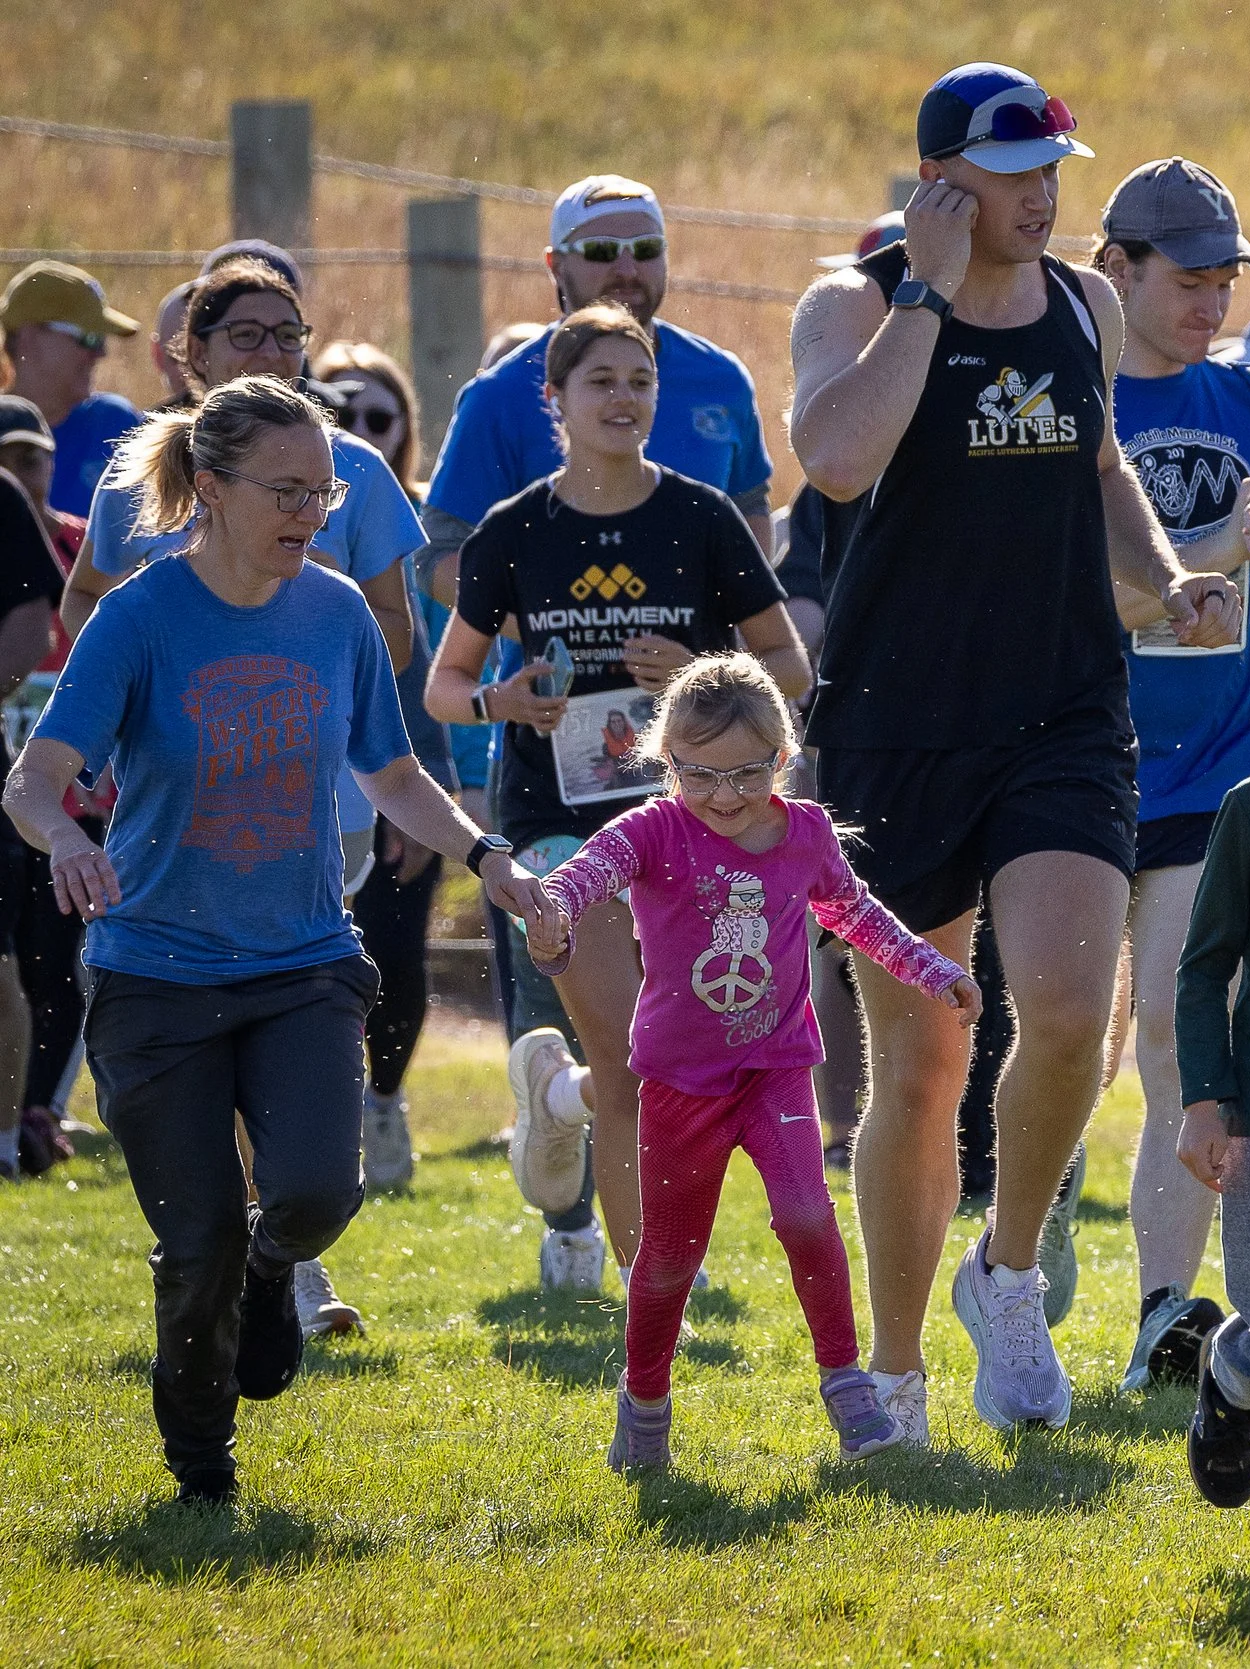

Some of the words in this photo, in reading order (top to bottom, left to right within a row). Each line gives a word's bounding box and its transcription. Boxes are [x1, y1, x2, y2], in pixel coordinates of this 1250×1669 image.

[1198, 189, 1228, 220] Y
[961, 355, 987, 366] asics
[968, 415, 1078, 447] LUTES
[968, 449, 995, 457] PACIFIC
[997, 447, 1036, 455] LUTHERAN
[1037, 445, 1079, 453] UNIVERSITY
[528, 606, 695, 632] MONUMENT
[206, 688, 305, 748] WATER
[207, 715, 311, 788] FIRE
